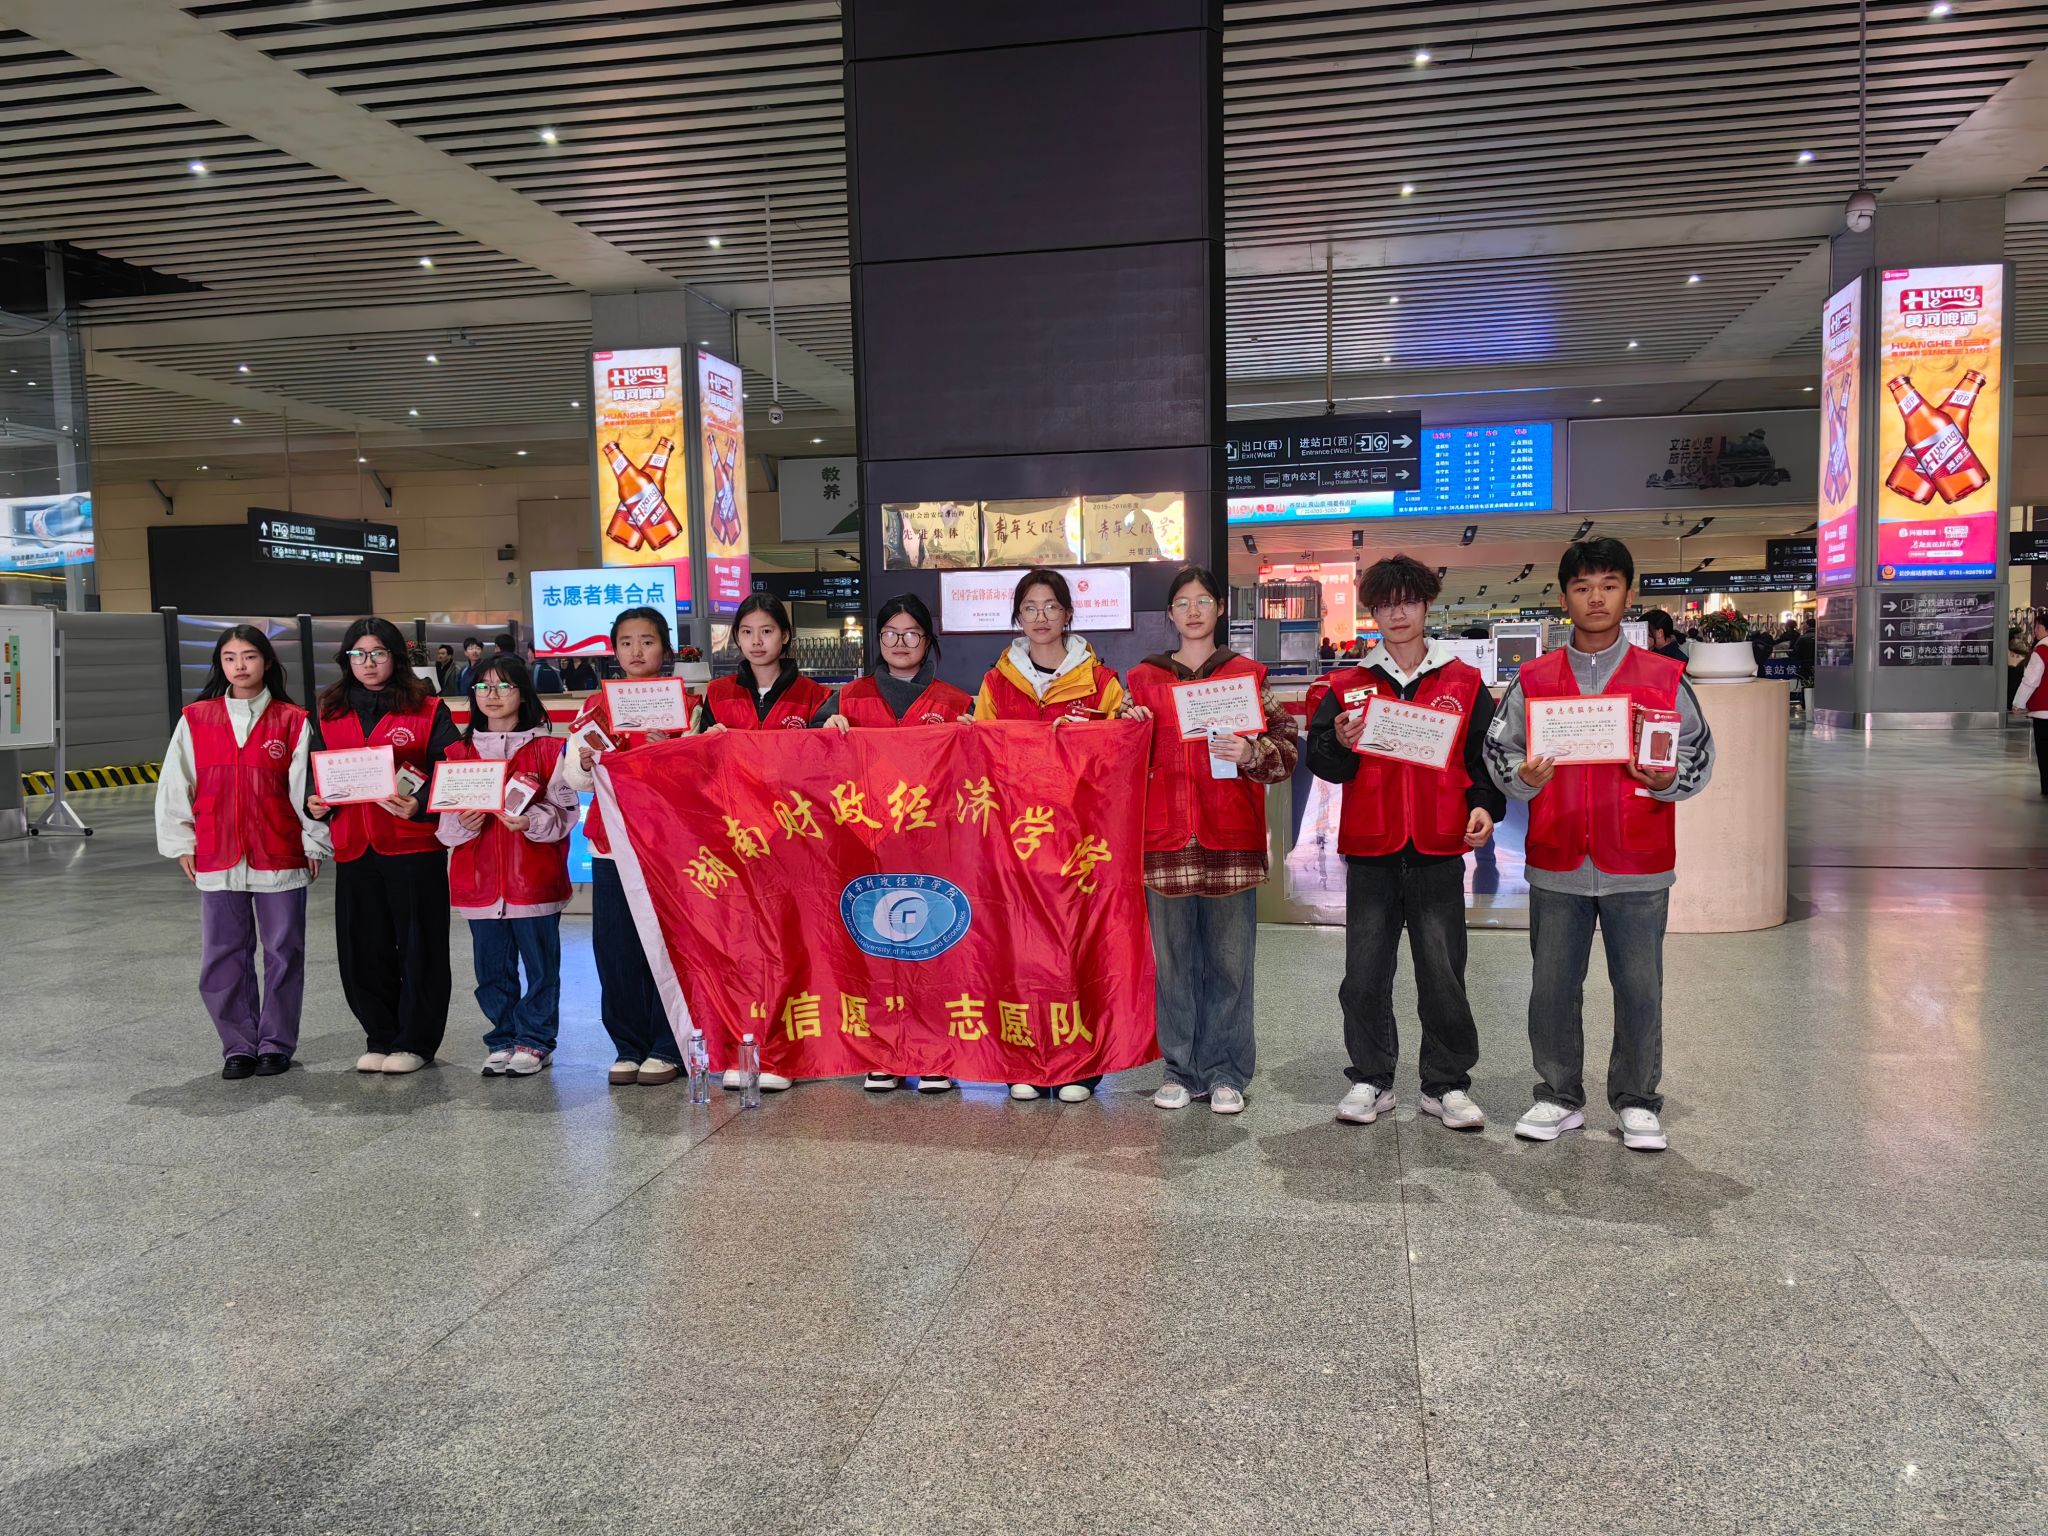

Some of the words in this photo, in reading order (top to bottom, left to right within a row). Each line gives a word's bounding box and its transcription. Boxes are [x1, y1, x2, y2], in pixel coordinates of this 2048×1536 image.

[1905, 311, 1977, 327] 黄河啤酒
[1891, 340, 1952, 350] HUANGHE
[1241, 440, 1283, 452] 出口(西)
[1300, 436, 1353, 449] 进站口(西)
[1301, 447, 1352, 456] Entrance(West)
[822, 466, 840, 500] 教养
[1282, 472, 1317, 481] 市内公交
[904, 528, 958, 540] 先进集体
[542, 582, 665, 606] 志愿者集合点
[1918, 622, 1945, 631] 东广场
[1764, 664, 1801, 676] 接站候
[681, 776, 1113, 899] 湖南财政经济学院
[845, 876, 959, 904] 湖南财政经济学院
[857, 935, 891, 955] University
[901, 948, 929, 956] Finance
[930, 940, 944, 952] and
[943, 910, 967, 943] Economics
[945, 992, 1094, 1048] 志愿队
